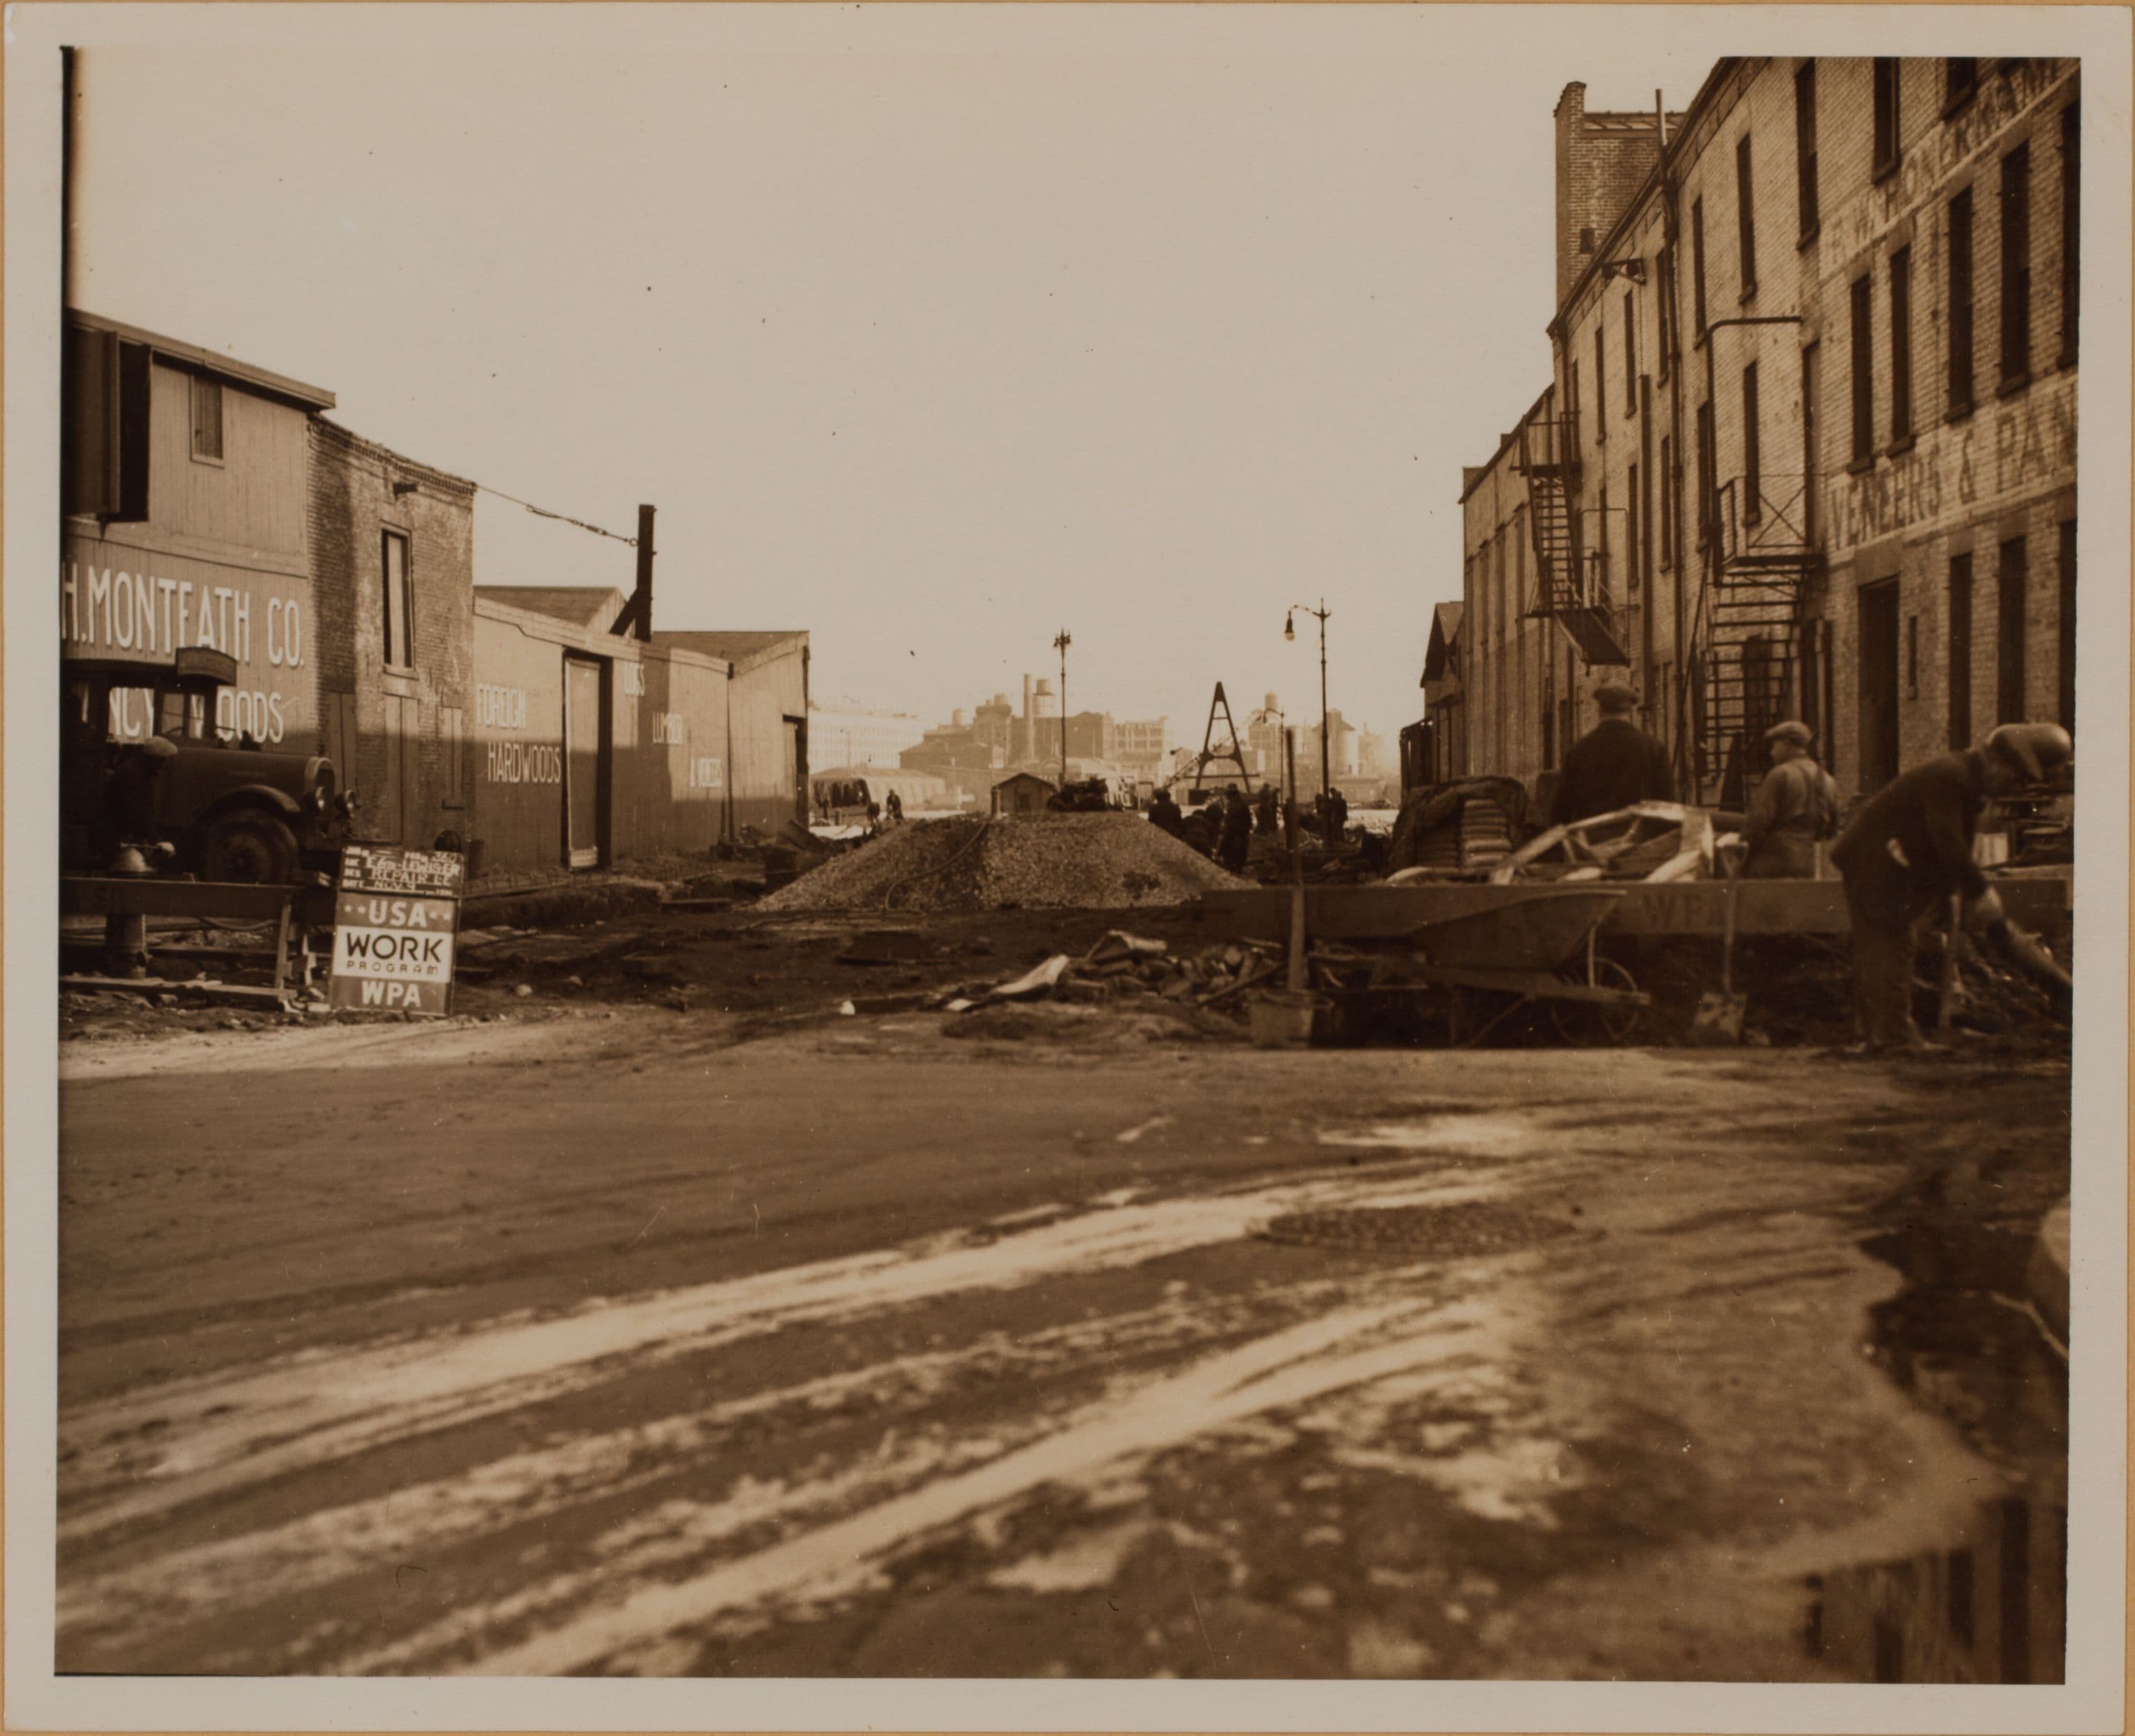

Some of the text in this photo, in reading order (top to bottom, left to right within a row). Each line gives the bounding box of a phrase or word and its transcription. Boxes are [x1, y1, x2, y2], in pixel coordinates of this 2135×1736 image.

[1830, 443, 1939, 551] VENEERS
[1959, 428, 1976, 504] &
[267, 596, 304, 667] CO.
[477, 682, 527, 729] FOREIGN
[487, 741, 561, 783] HARDWOODS
[369, 899, 427, 928] USA
[346, 932, 444, 963] WORK
[346, 960, 438, 975] PROGRAM
[361, 980, 421, 1007] WPA
